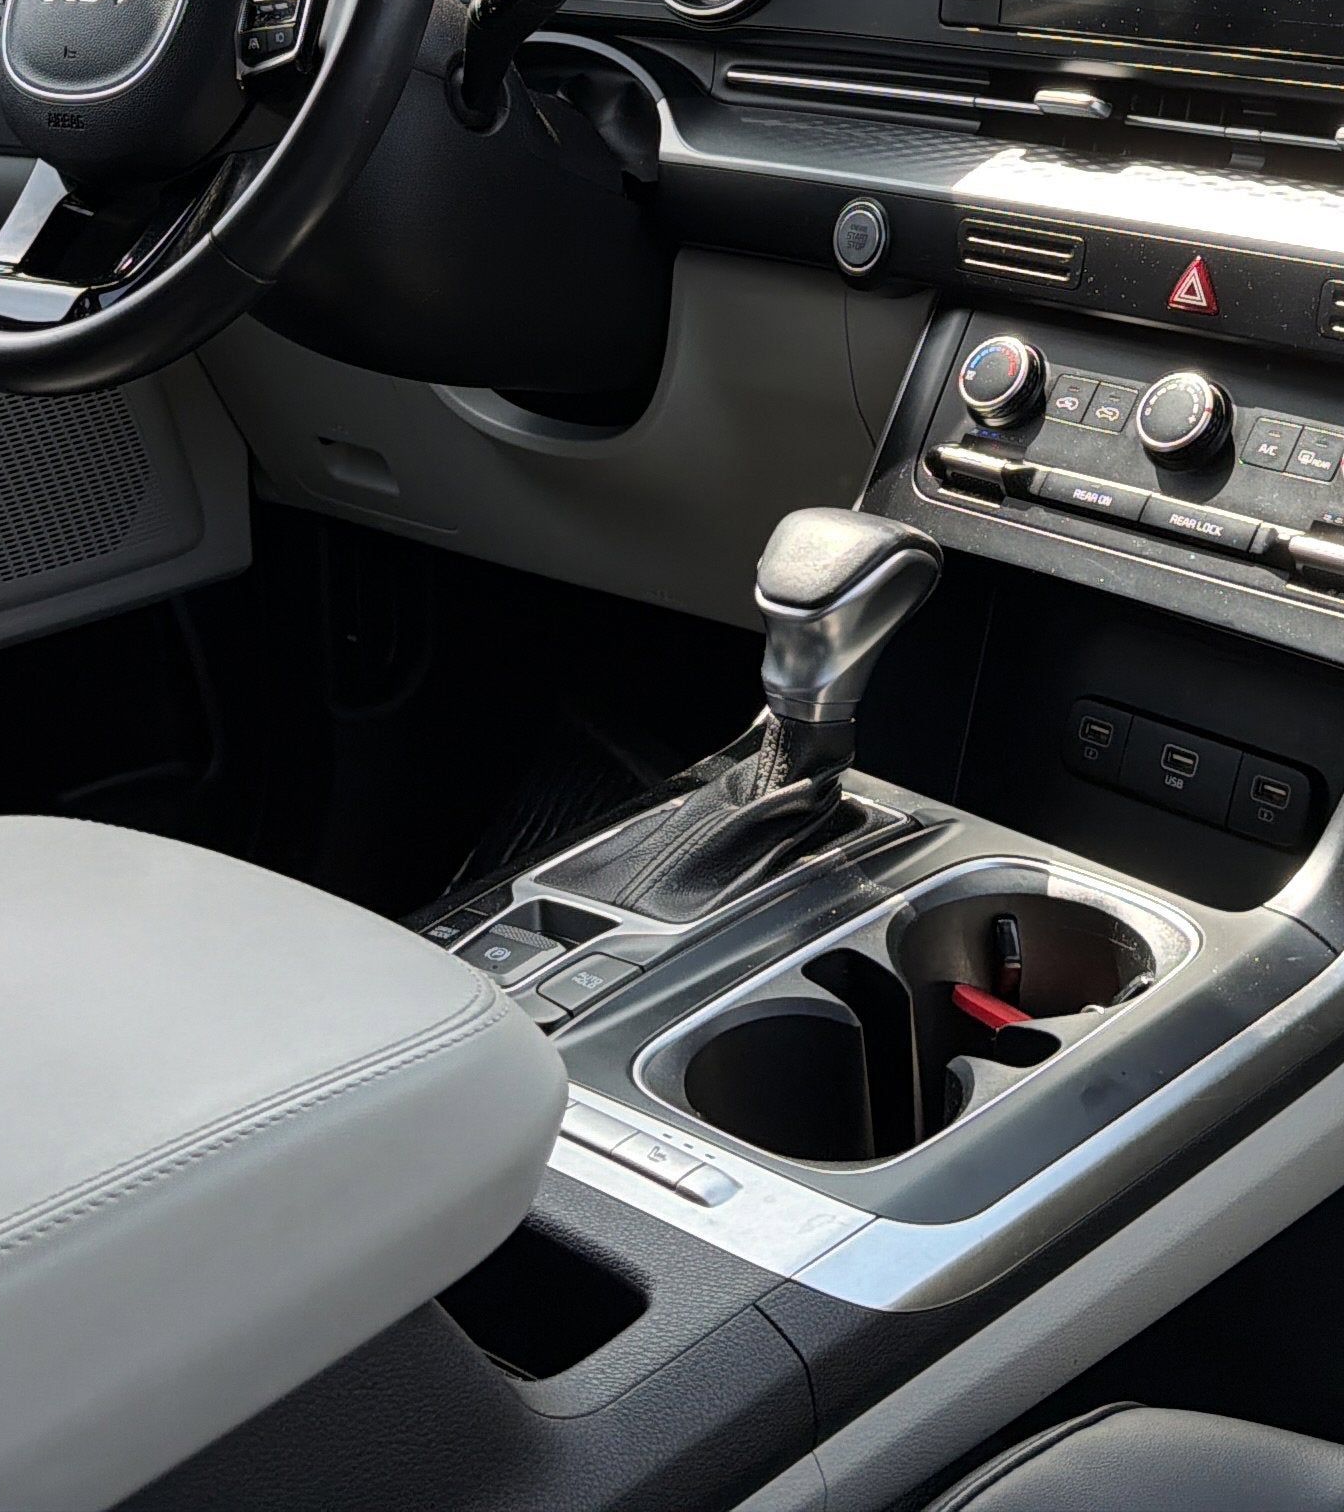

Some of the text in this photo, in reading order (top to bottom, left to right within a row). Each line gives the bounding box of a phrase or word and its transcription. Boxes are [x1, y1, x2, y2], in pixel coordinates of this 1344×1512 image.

[847, 231, 869, 241] START
[847, 240, 865, 251] STOP
[1258, 442, 1278, 457] A/C
[1311, 458, 1332, 471] REAR
[1072, 488, 1113, 507] REAR ON
[1169, 513, 1225, 538] REAR LOCK
[1164, 774, 1184, 790] USB
[571, 975, 597, 989] HOLD
[577, 971, 604, 985] AUTO
